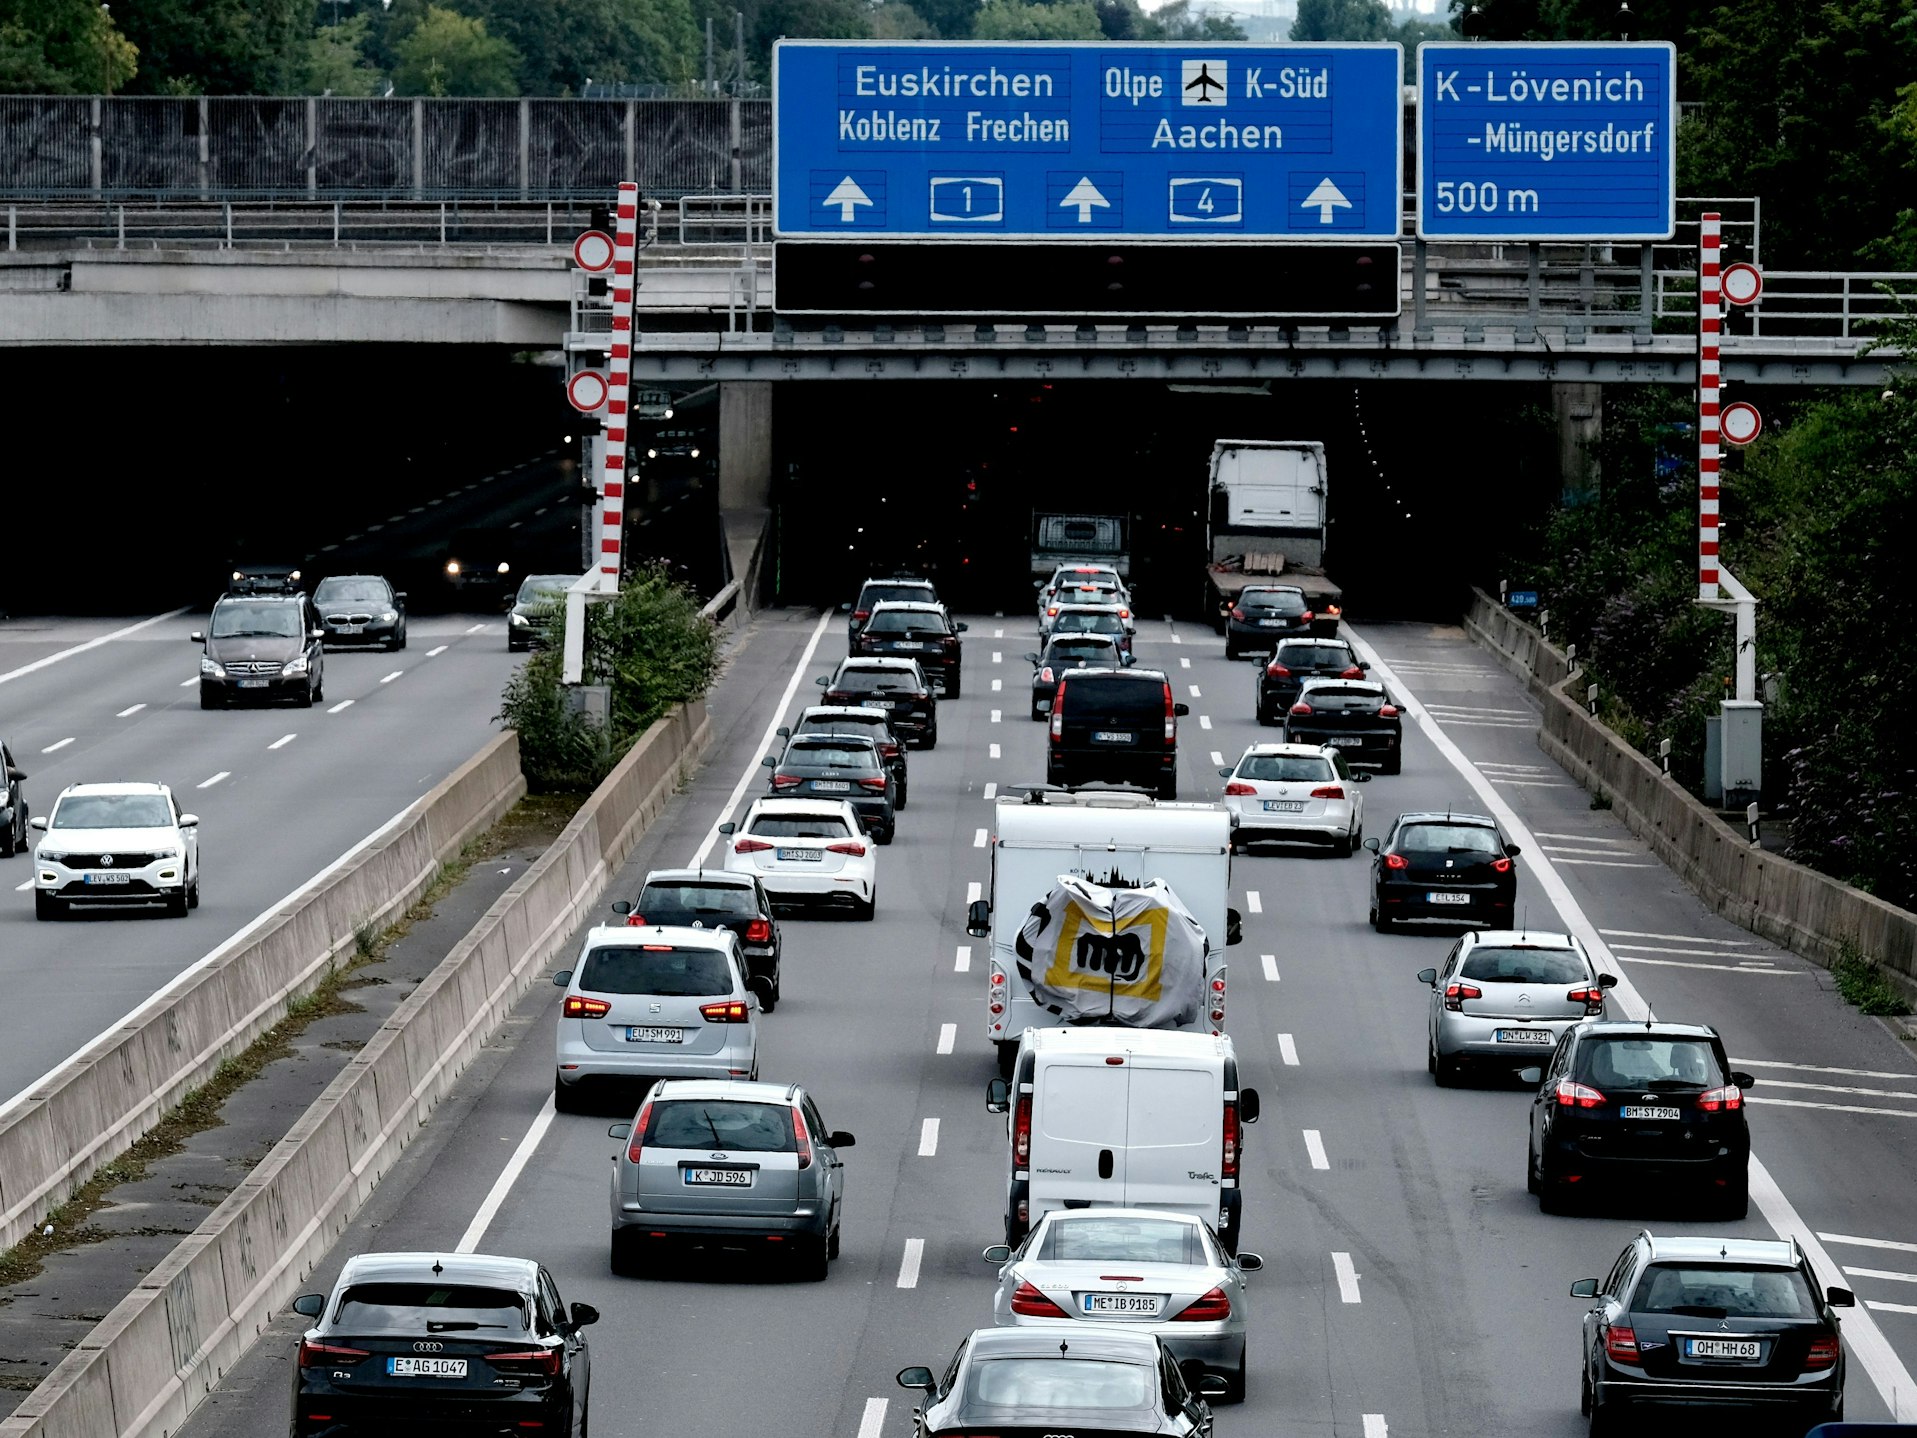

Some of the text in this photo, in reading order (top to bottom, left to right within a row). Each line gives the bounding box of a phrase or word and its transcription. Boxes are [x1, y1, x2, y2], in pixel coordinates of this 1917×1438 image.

[856, 65, 1054, 97] Euskirchen
[1105, 66, 1328, 105] Olpe K-Süd
[1436, 70, 1644, 102] K-Lövenich
[839, 111, 1070, 142] Koblenz Frechen
[1151, 118, 1284, 150] Aachen
[1467, 121, 1655, 162] -Müngersdorf
[961, 186, 972, 212] 1
[1197, 187, 1215, 214] 4
[1436, 181, 1539, 213] 500 m
[664, 1029, 681, 1040] 991
[1533, 1031, 1548, 1041] 321
[1657, 1108, 1679, 1118] 2904
[725, 1172, 746, 1183] 596
[1129, 1298, 1155, 1310] 9185
[1740, 1343, 1755, 1355] 68
[395, 1359, 466, 1375] E AG 1047
